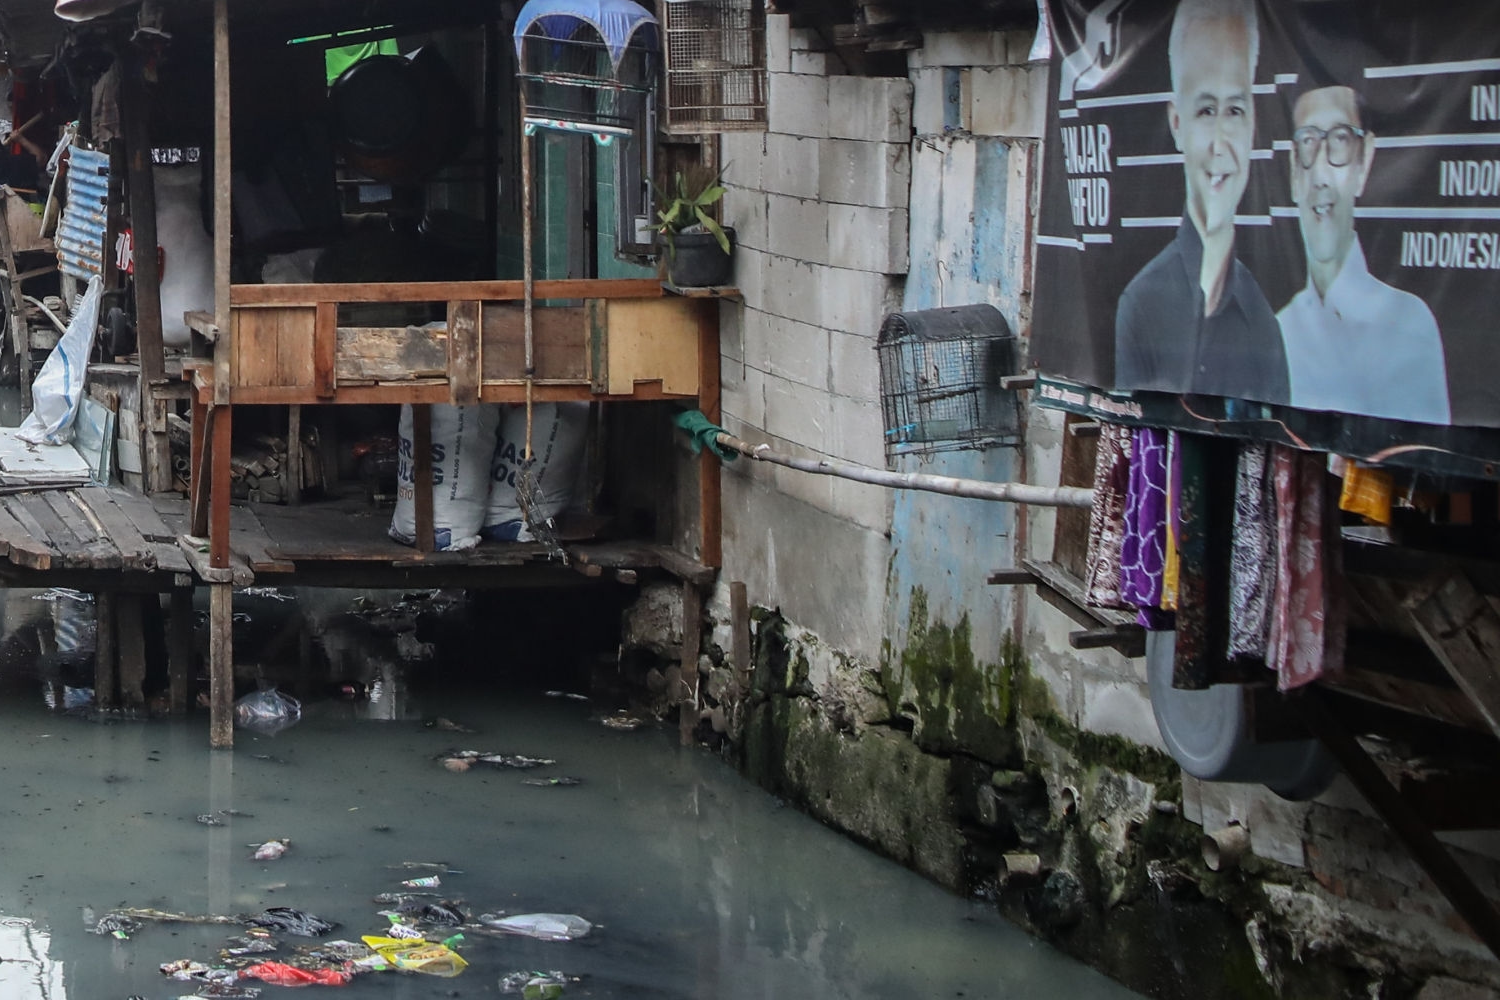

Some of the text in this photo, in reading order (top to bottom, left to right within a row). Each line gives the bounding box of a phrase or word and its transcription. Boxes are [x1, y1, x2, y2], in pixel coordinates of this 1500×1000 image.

[1470, 84, 1500, 121] IN
[1060, 124, 1112, 174] ANJAR
[1068, 177, 1111, 227] HFUD
[1400, 231, 1500, 270] INDONESI
